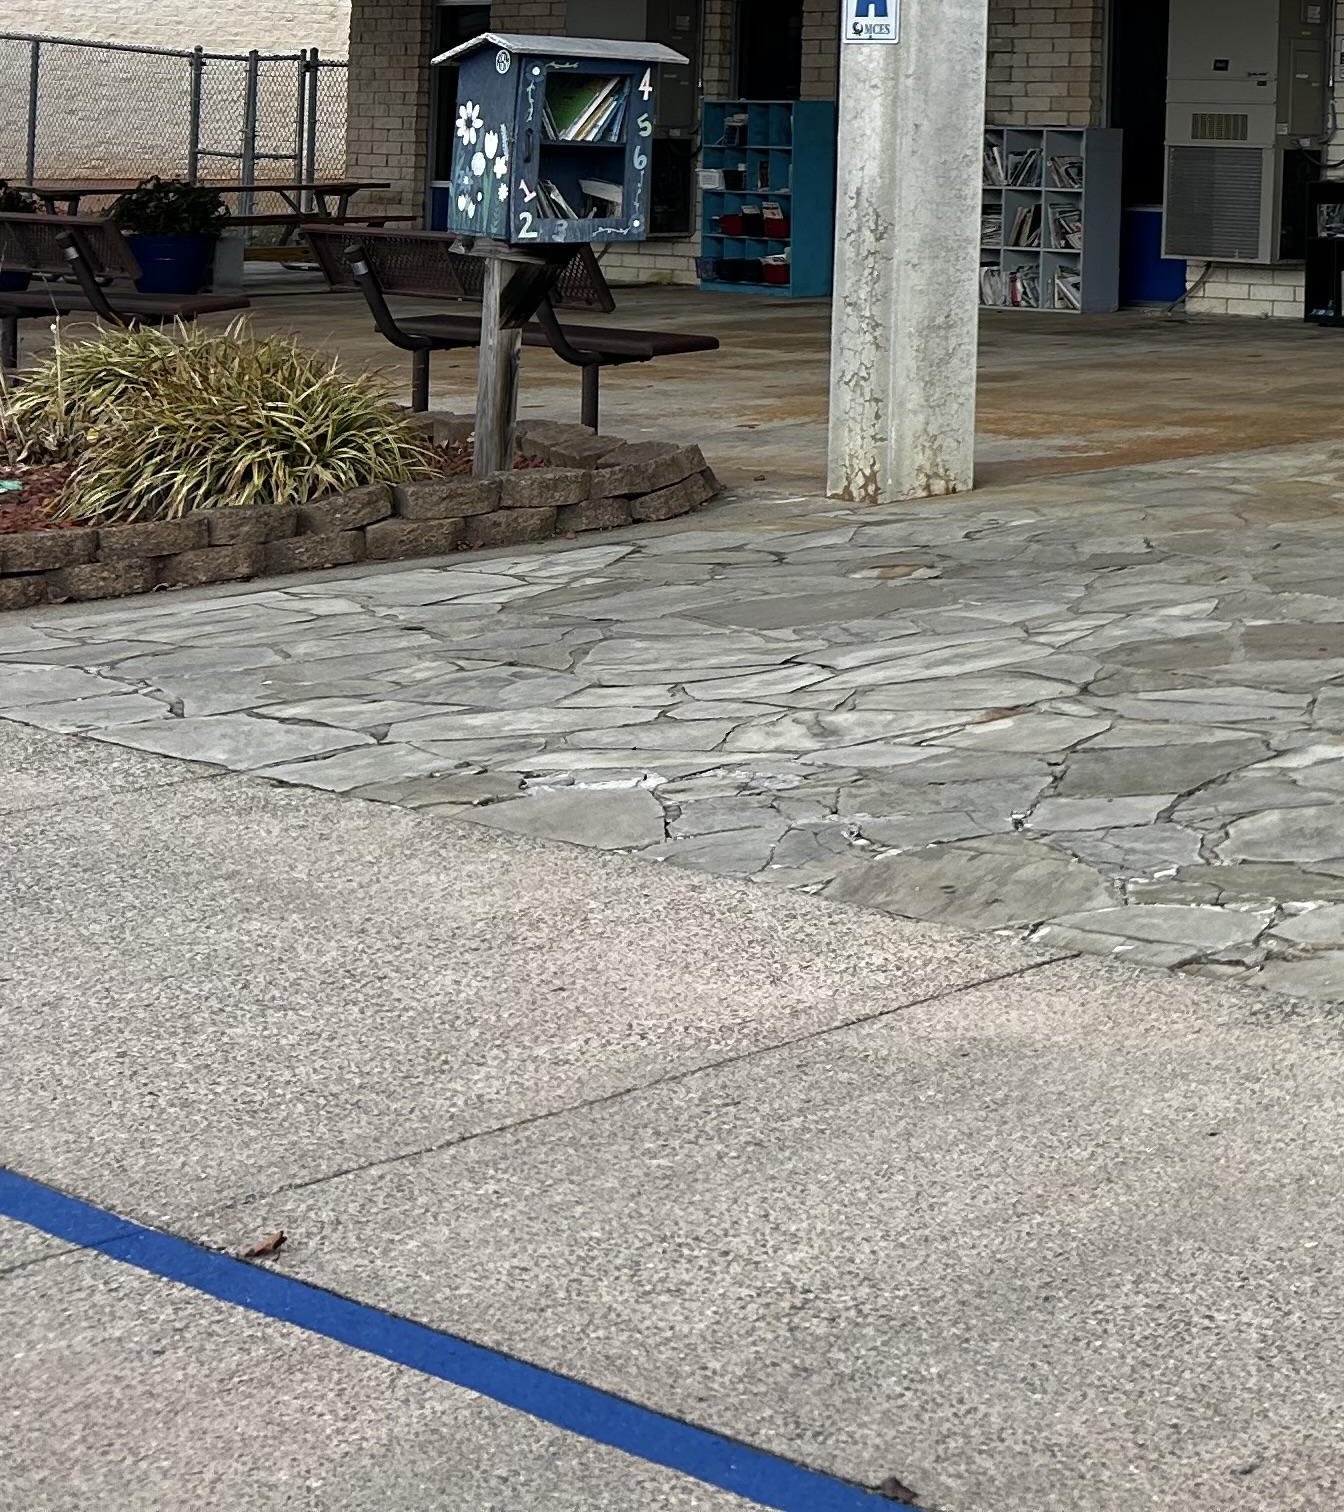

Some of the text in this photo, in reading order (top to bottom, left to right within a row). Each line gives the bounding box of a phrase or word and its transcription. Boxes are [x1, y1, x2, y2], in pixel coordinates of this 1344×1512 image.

[864, 23, 890, 35] MCES
[638, 68, 653, 101] 4
[637, 113, 652, 137] 5
[633, 145, 647, 170] 6
[519, 179, 537, 203] 1
[518, 211, 538, 239] 2
[552, 219, 569, 242] 3
